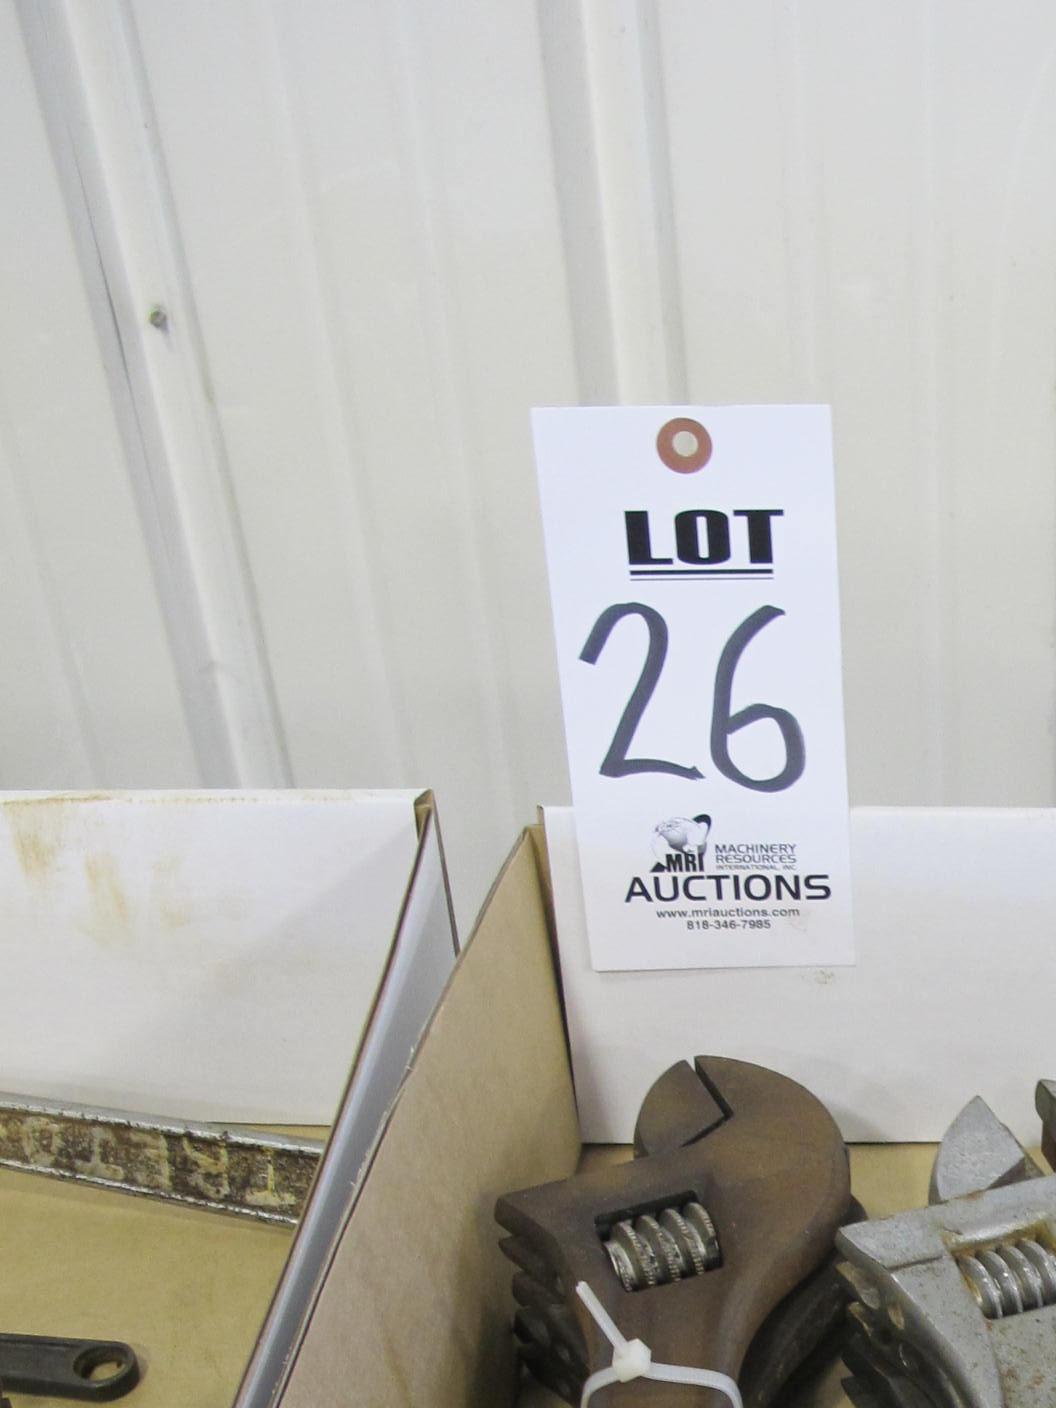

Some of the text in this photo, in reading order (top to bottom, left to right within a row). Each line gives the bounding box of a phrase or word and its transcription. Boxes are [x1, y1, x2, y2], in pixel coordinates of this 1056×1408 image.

[625, 509, 784, 566] LOT
[579, 602, 806, 793] 26
[714, 843, 797, 854] MACHINERY
[665, 852, 705, 872] MRI
[715, 854, 797, 864] RESOURCES
[625, 874, 832, 903] AUCTIONS
[655, 907, 801, 919] www.mriauctions.com
[686, 919, 772, 931] 818-346-7985
